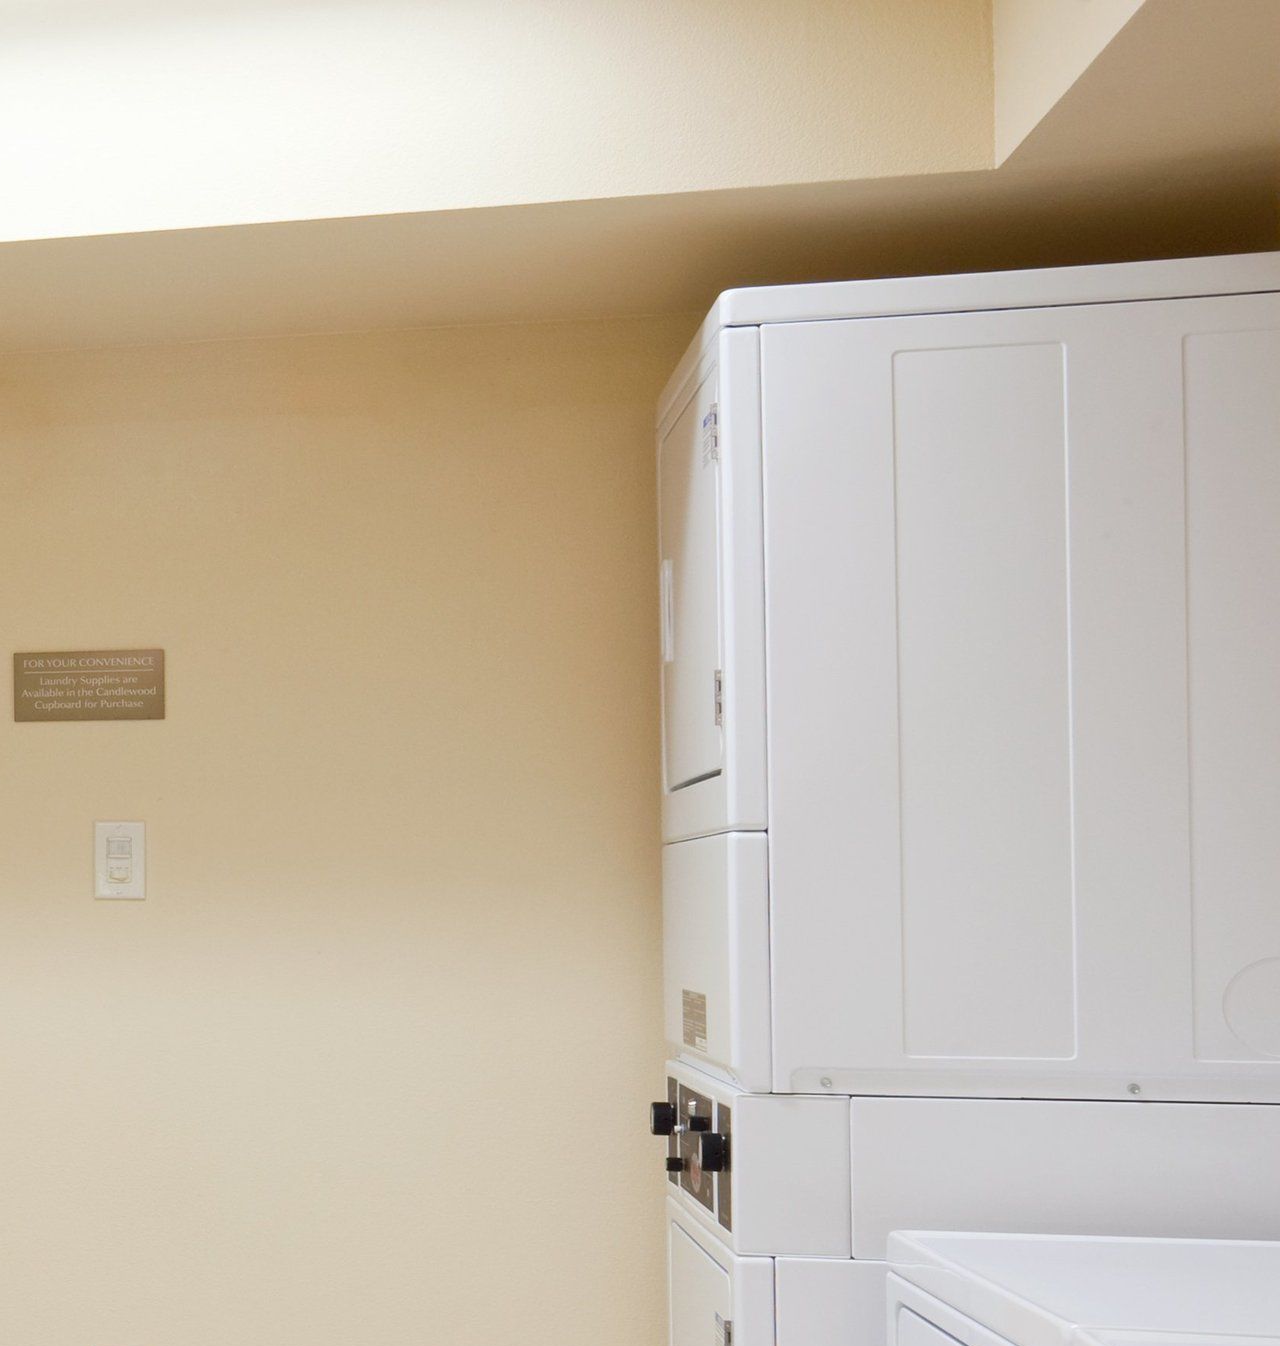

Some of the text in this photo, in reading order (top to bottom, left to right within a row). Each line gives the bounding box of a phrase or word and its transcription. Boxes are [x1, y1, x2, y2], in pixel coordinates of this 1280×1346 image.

[24, 657, 154, 668] FOR YOUR CONVENIENCE
[40, 676, 77, 686] Laundry
[80, 675, 120, 686] Supplies
[22, 689, 64, 697] Available
[78, 688, 93, 696] the
[96, 687, 156, 696] Candlewood
[34, 699, 143, 711] Cupboard for Purchase
